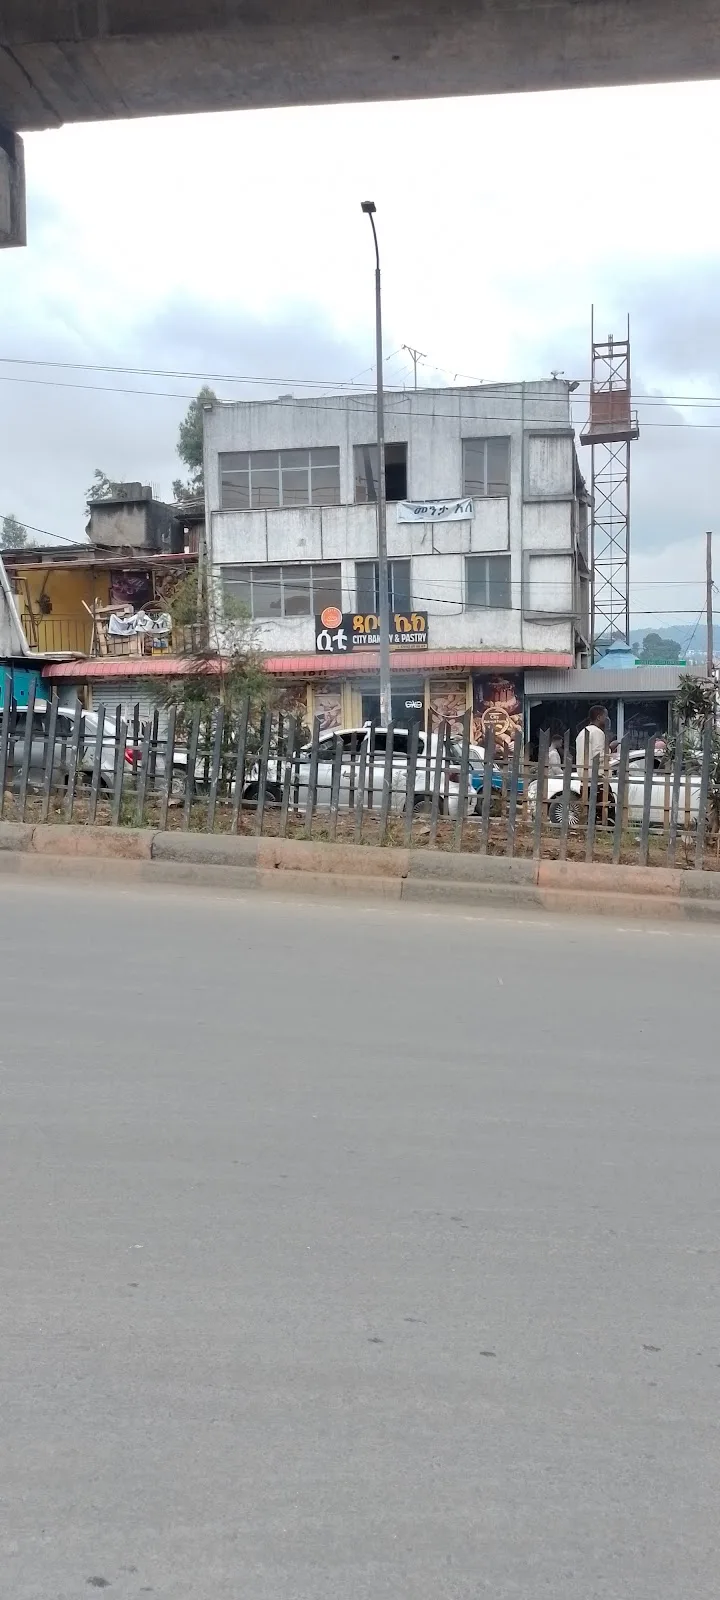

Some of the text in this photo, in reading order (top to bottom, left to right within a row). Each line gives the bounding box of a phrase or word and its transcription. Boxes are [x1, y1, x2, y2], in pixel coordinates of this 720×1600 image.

[352, 614, 381, 634] ዳቦ
[352, 633, 427, 644] CITY BAKY & PASTRY
